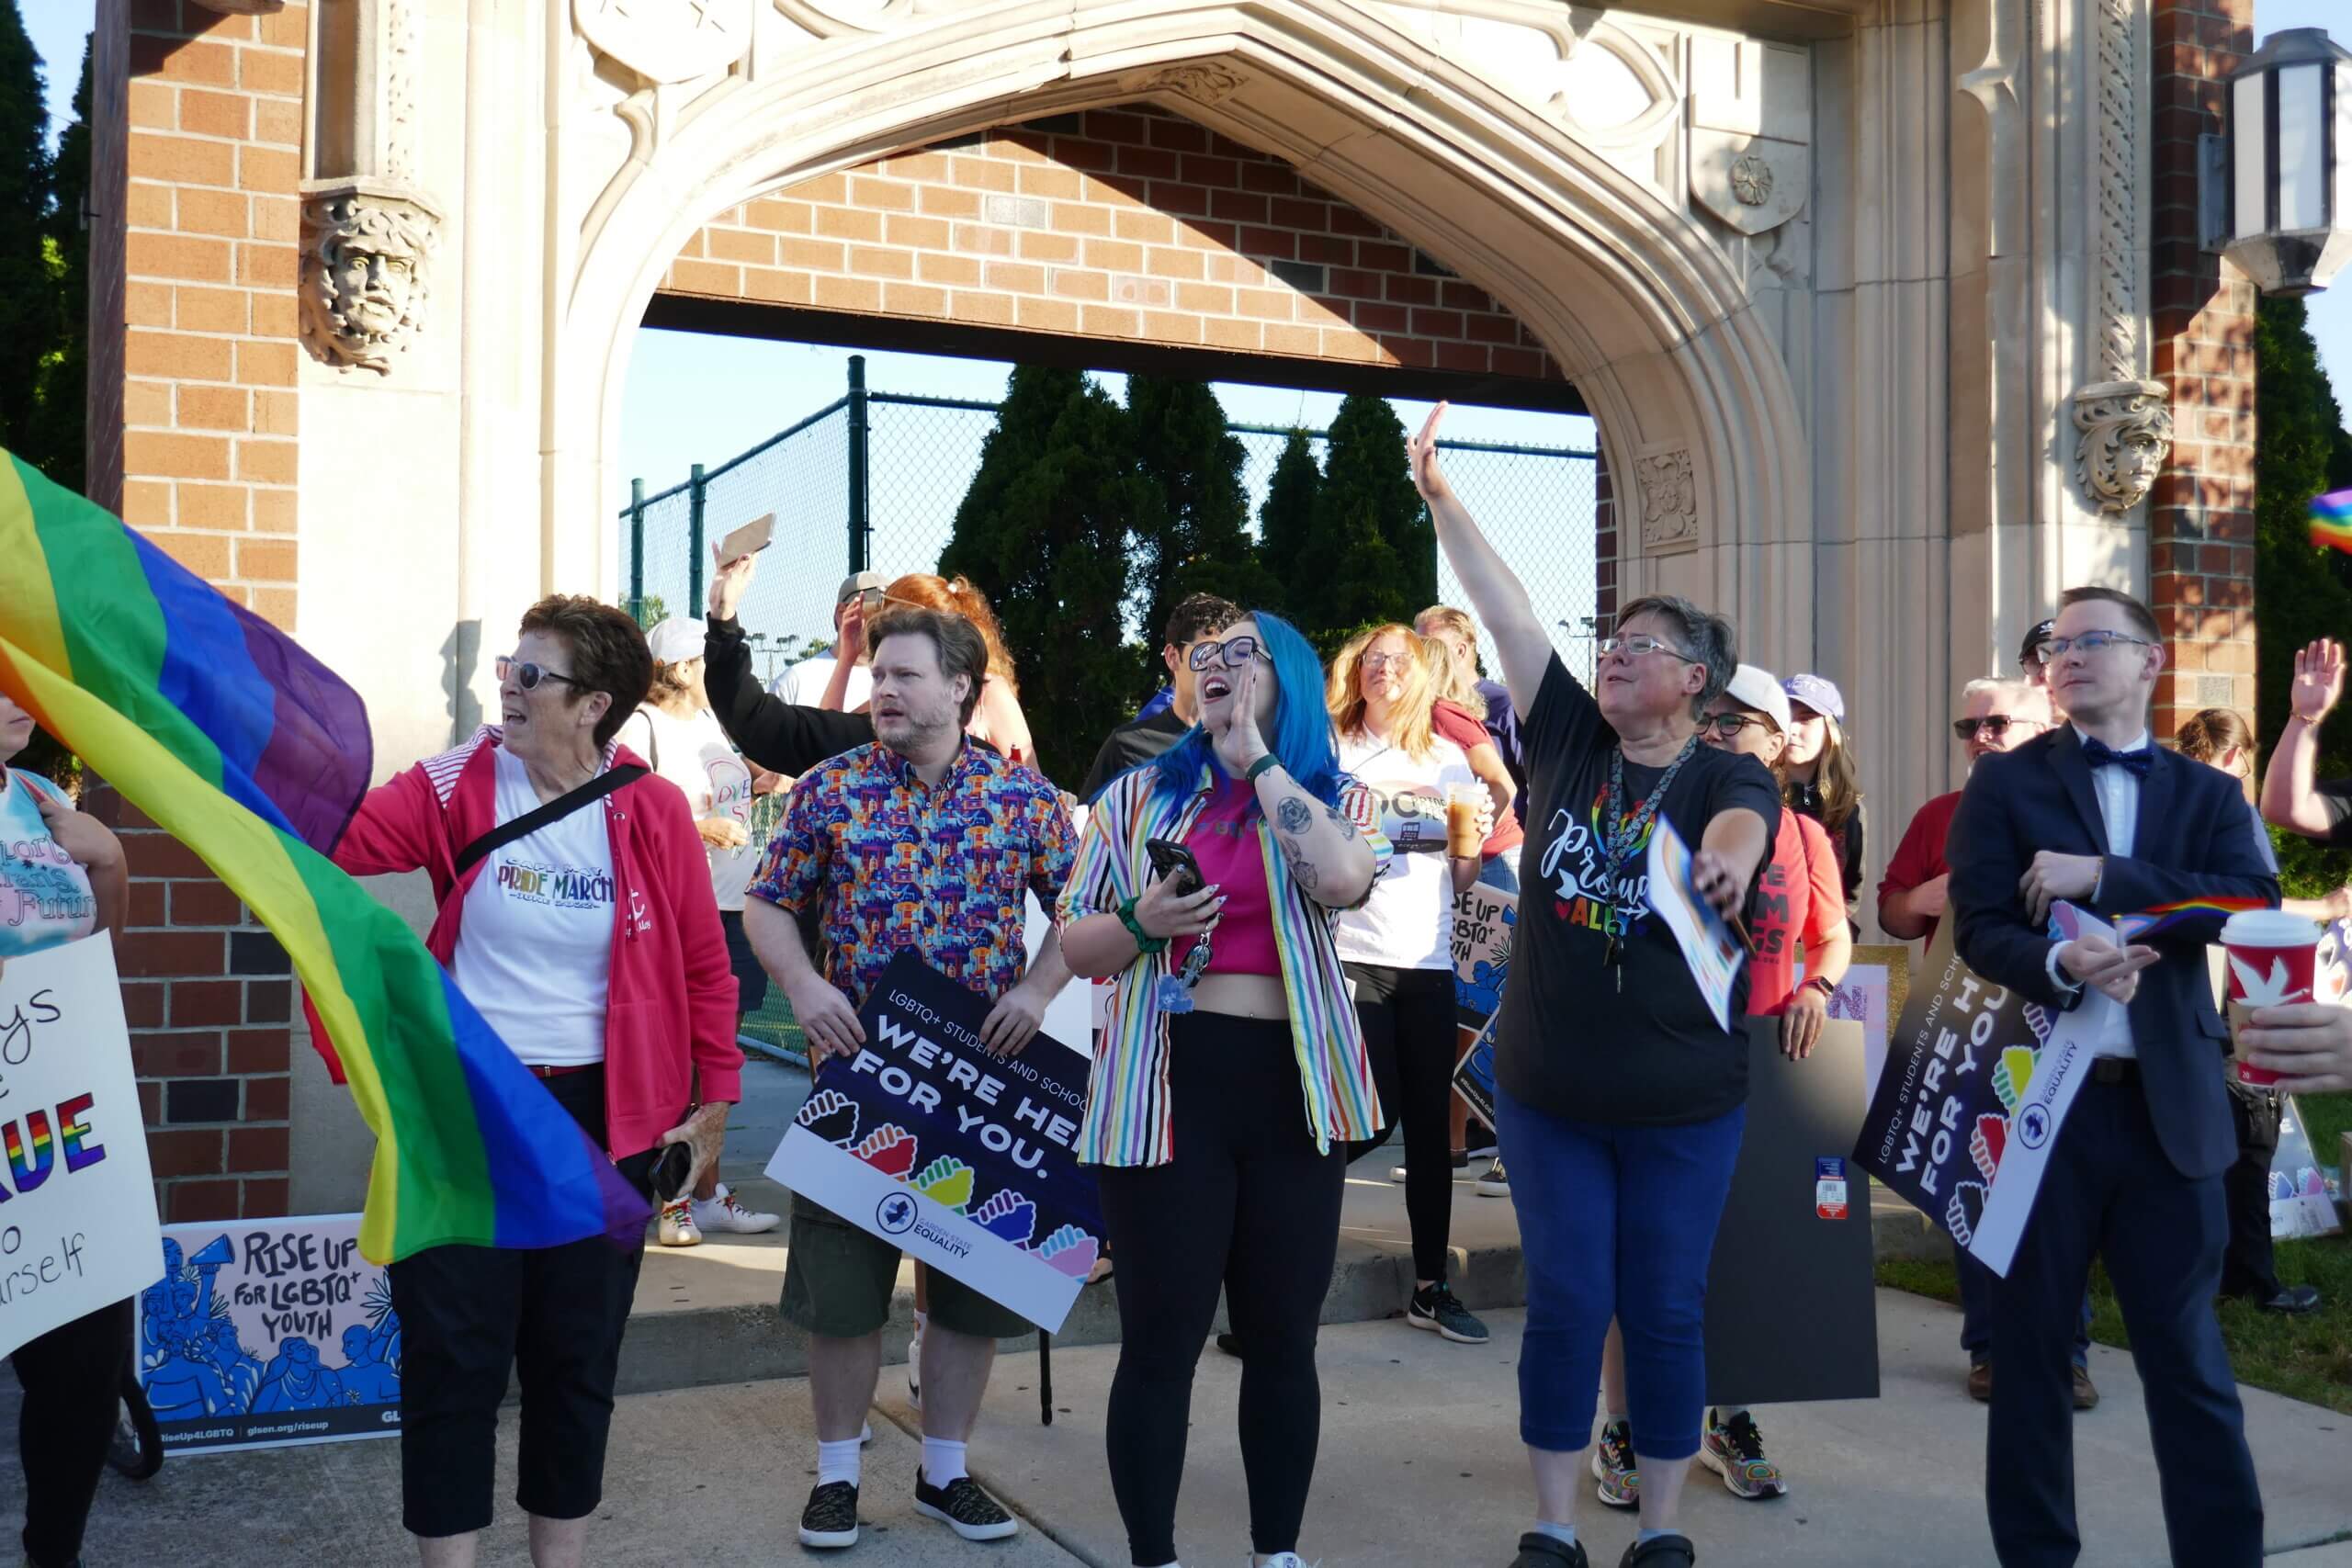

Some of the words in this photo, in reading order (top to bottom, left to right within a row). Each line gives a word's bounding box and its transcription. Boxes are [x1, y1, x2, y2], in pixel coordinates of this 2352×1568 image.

[498, 865, 548, 897] PRIDE
[552, 874, 616, 903] MARCH
[7, 889, 96, 926] Futur
[1476, 898, 1499, 922] UP
[1453, 917, 1496, 944] BTQ+
[888, 988, 941, 1025] LGBTQ+
[1008, 1058, 1038, 1082] AND
[1878, 1108, 1904, 1164] LGBTQ+
[1899, 1031, 1929, 1103] STUDENTS
[1925, 994, 1943, 1028] AND
[2043, 1041, 2077, 1105] EQUALITY
[850, 1048, 942, 1114] FOR
[956, 1104, 1047, 1179] YOU.
[0, 1091, 107, 1203] UE
[1920, 1095, 1963, 1196] FOR
[243, 1232, 319, 1278] RISE
[324, 1237, 357, 1270] UP
[913, 1224, 969, 1259] EQUALITY
[235, 1282, 266, 1305] FOR
[271, 1271, 361, 1311] LGBTQ+
[261, 1308, 333, 1343] YOUTH
[247, 1421, 329, 1437] glsen.org/riseup
